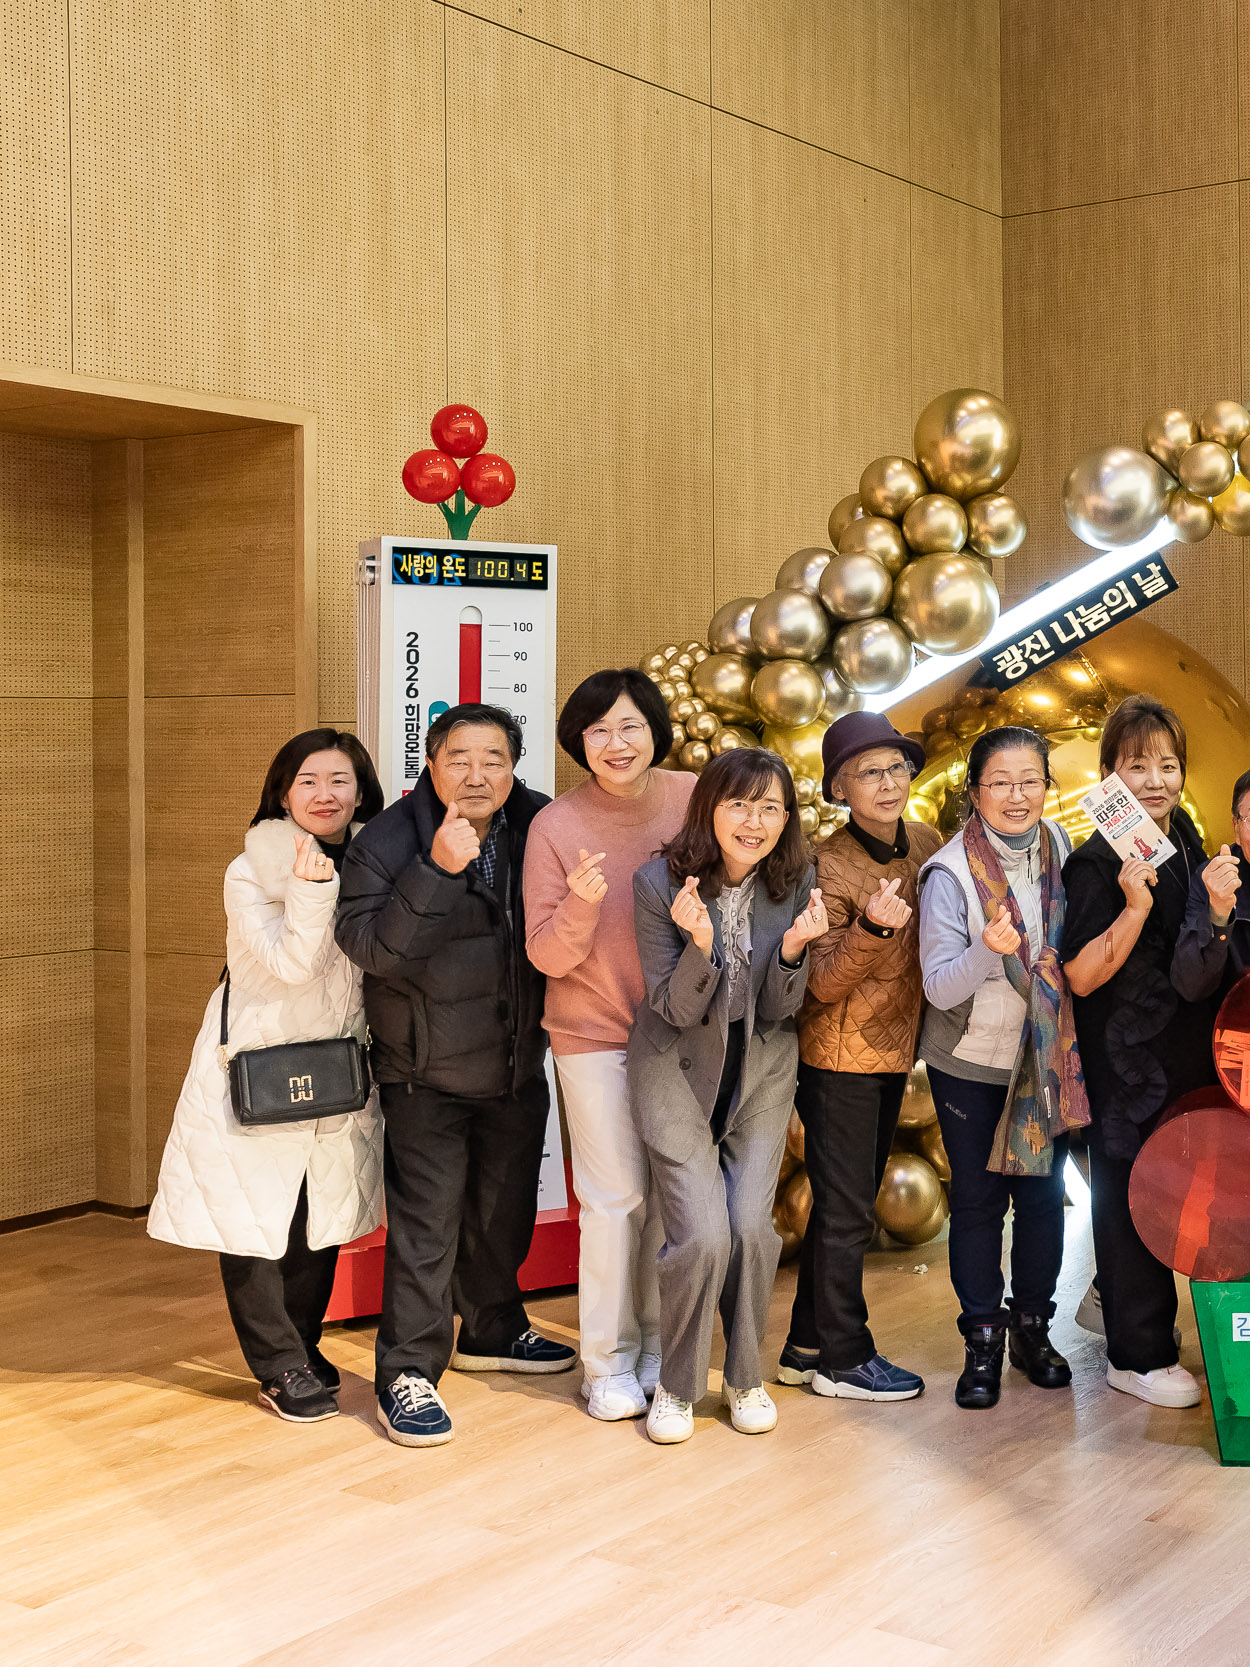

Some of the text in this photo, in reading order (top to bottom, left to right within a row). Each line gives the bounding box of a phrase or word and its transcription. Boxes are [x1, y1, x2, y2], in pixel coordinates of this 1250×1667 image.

[400, 553, 437, 577] 사랑의
[442, 555, 467, 578] 온도
[513, 622, 533, 632] 100
[992, 562, 1169, 680] 광진 나눔의 날
[405, 632, 420, 699] 2026
[513, 651, 528, 661] 90
[513, 684, 527, 693] 80
[404, 704, 421, 779] 희망온돌
[1092, 803, 1105, 815] 2026
[1096, 795, 1130, 824] 따뜻한
